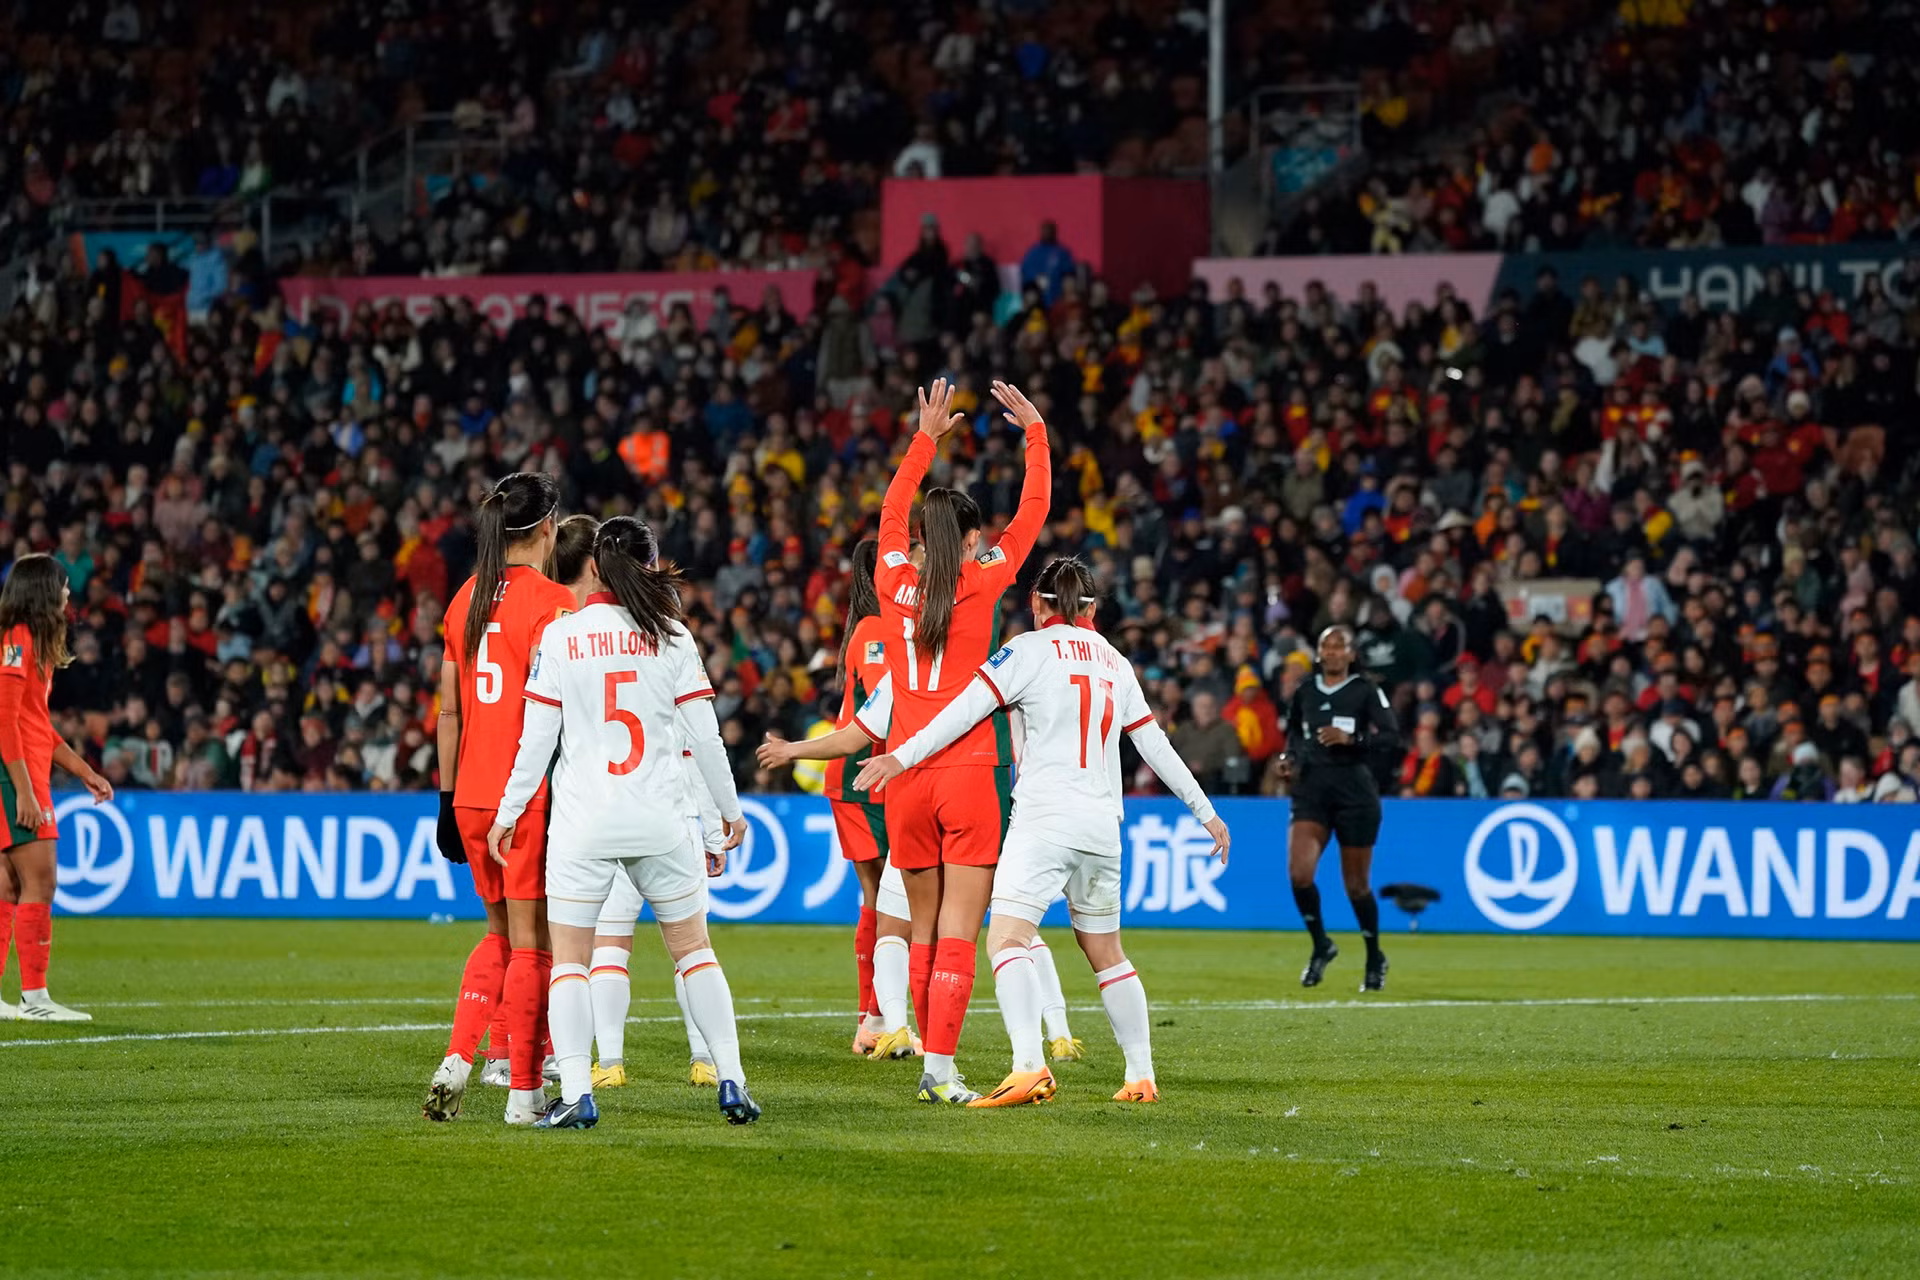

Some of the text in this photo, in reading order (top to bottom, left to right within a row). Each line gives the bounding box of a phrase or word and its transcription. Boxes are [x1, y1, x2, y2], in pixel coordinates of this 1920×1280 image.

[476, 622, 503, 704] 5
[567, 636, 584, 660] H.
[587, 632, 614, 657] THI
[1052, 640, 1068, 660] T.
[1068, 640, 1092, 661] THI
[604, 670, 645, 775] 5
[148, 815, 456, 900] WANDA
